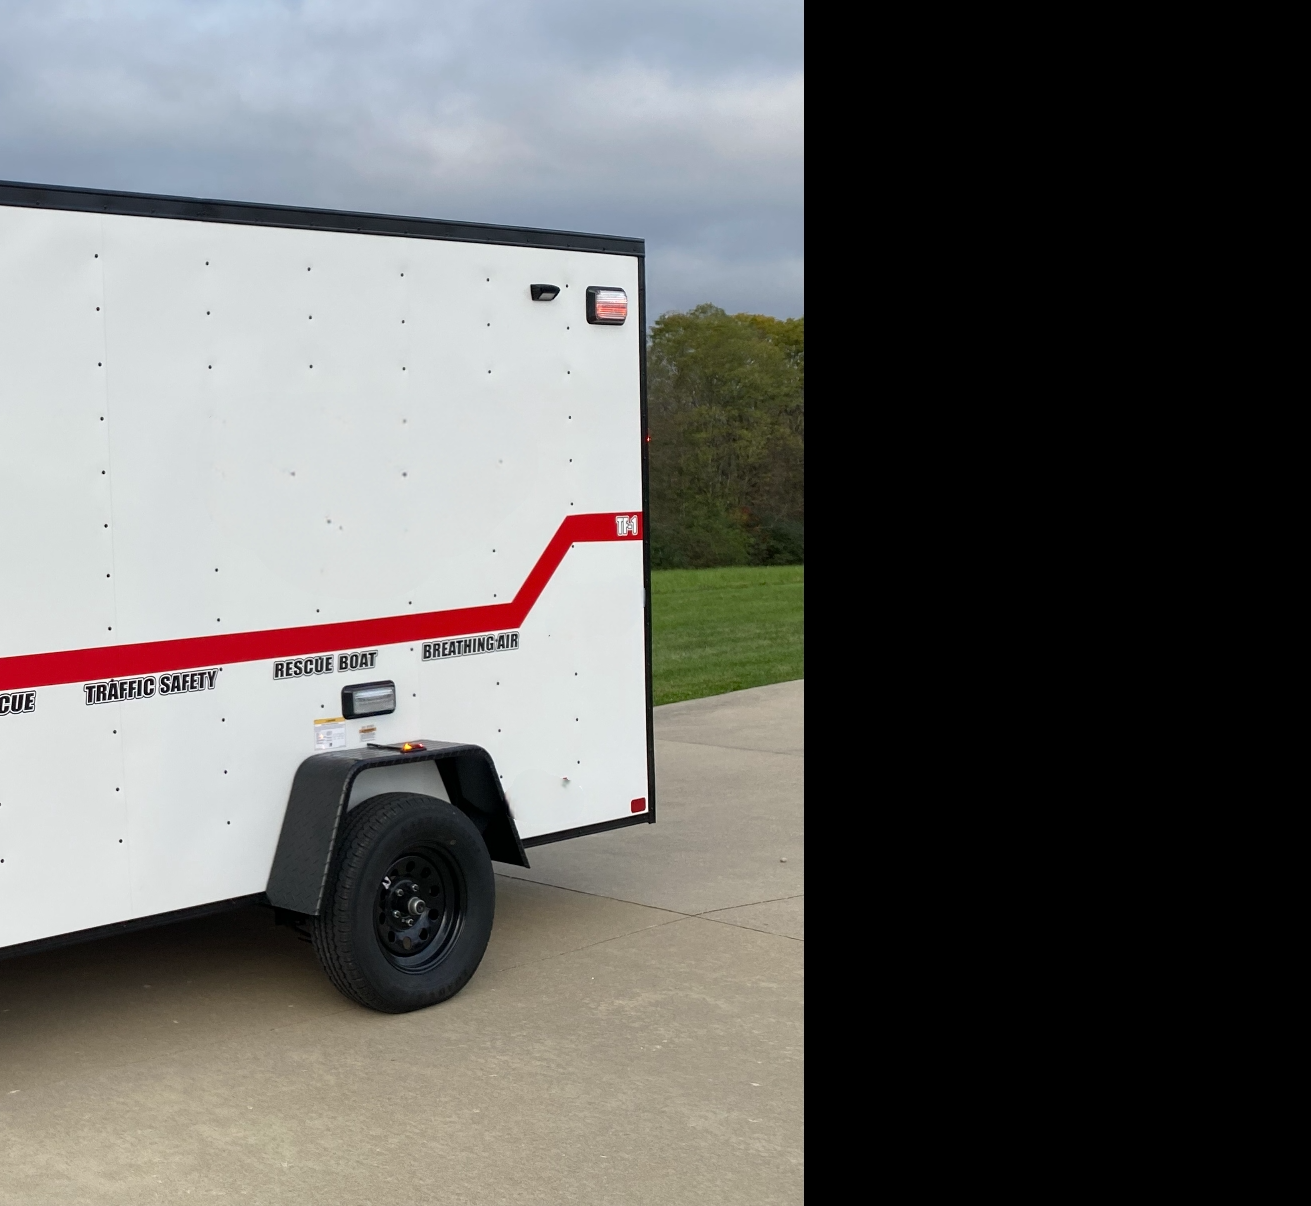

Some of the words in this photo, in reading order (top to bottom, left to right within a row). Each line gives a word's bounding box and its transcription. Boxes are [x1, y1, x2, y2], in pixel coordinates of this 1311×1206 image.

[422, 637, 495, 661] BREATHING
[495, 631, 519, 651] AIR
[273, 654, 334, 680] RESCUE
[338, 650, 378, 672] BOAT
[84, 676, 157, 705] TRAFFIC
[159, 668, 218, 696] SAFETY
